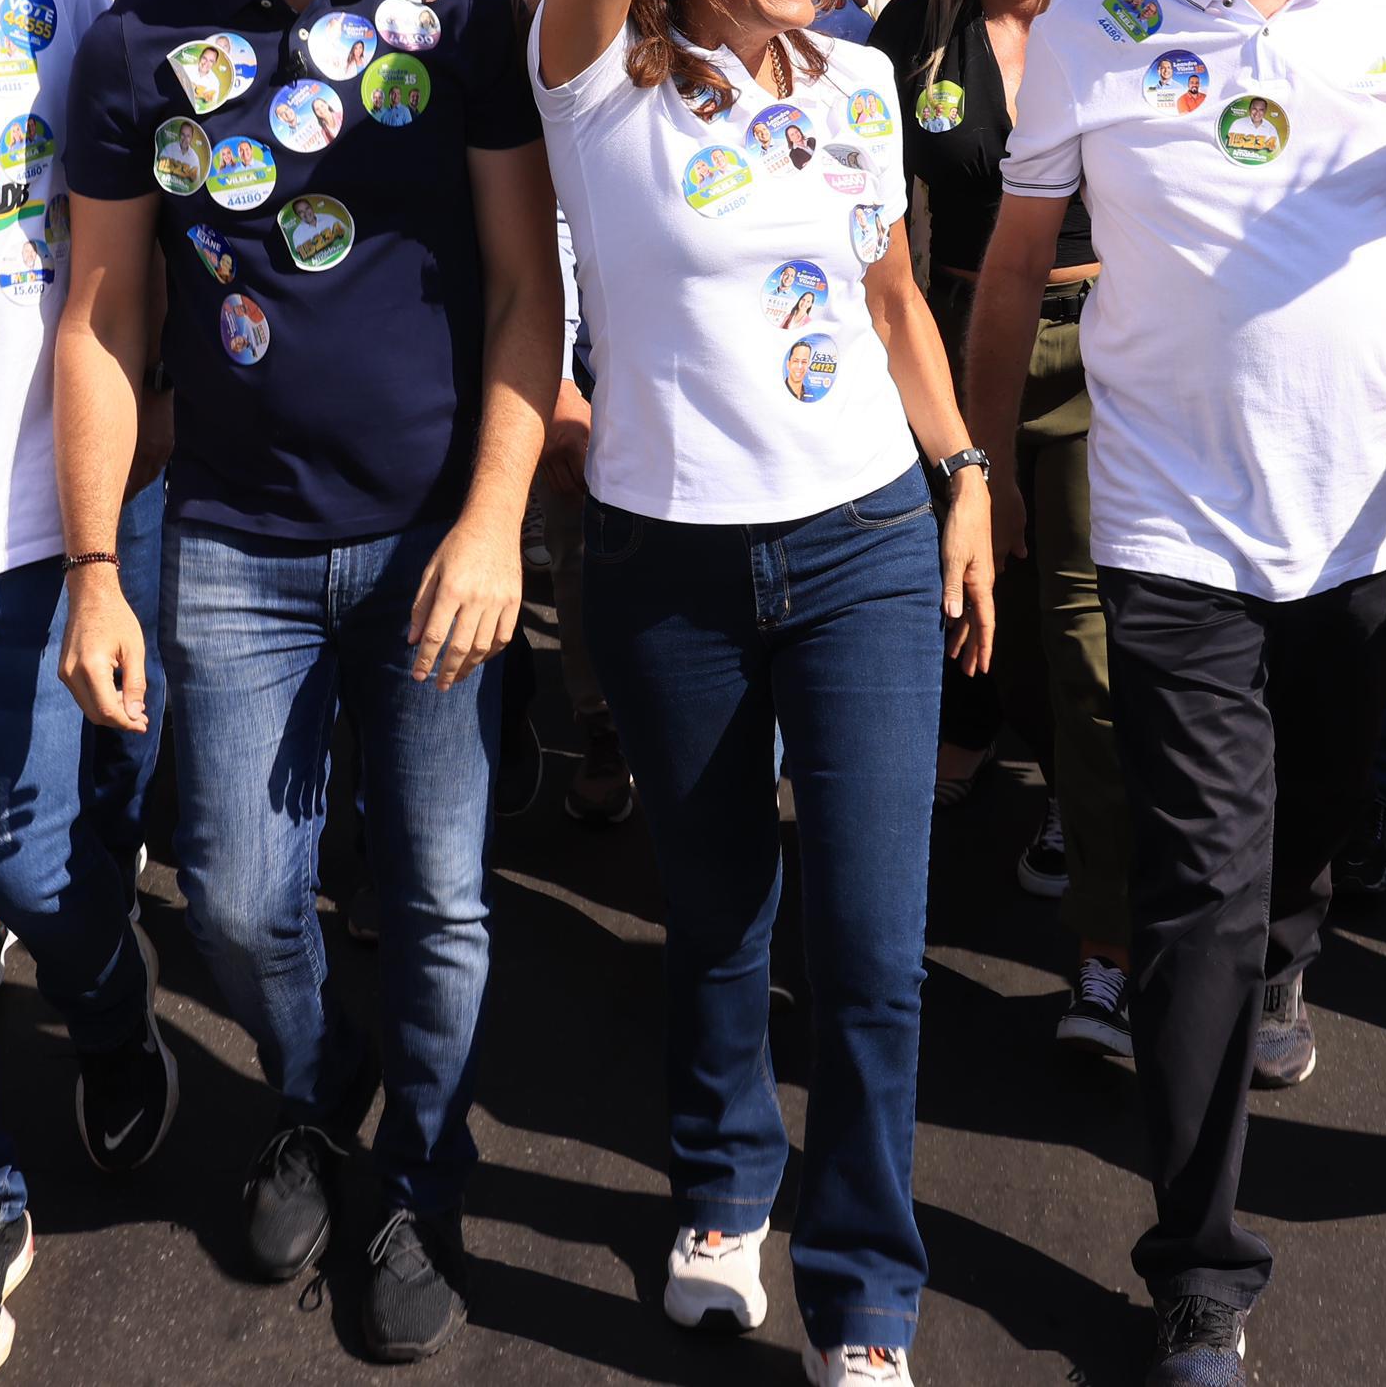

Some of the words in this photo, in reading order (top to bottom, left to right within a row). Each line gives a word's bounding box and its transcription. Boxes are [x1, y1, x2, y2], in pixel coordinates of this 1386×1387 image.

[3, 11, 52, 39] 44555
[1097, 18, 1121, 43] 44180
[1172, 60, 1198, 68] Leandro
[403, 73, 417, 85] 15
[1226, 132, 1276, 152] 15234
[227, 192, 263, 207] 44180
[716, 196, 747, 217] 44180
[796, 272, 821, 282] Leandro
[810, 362, 835, 373] 44123
